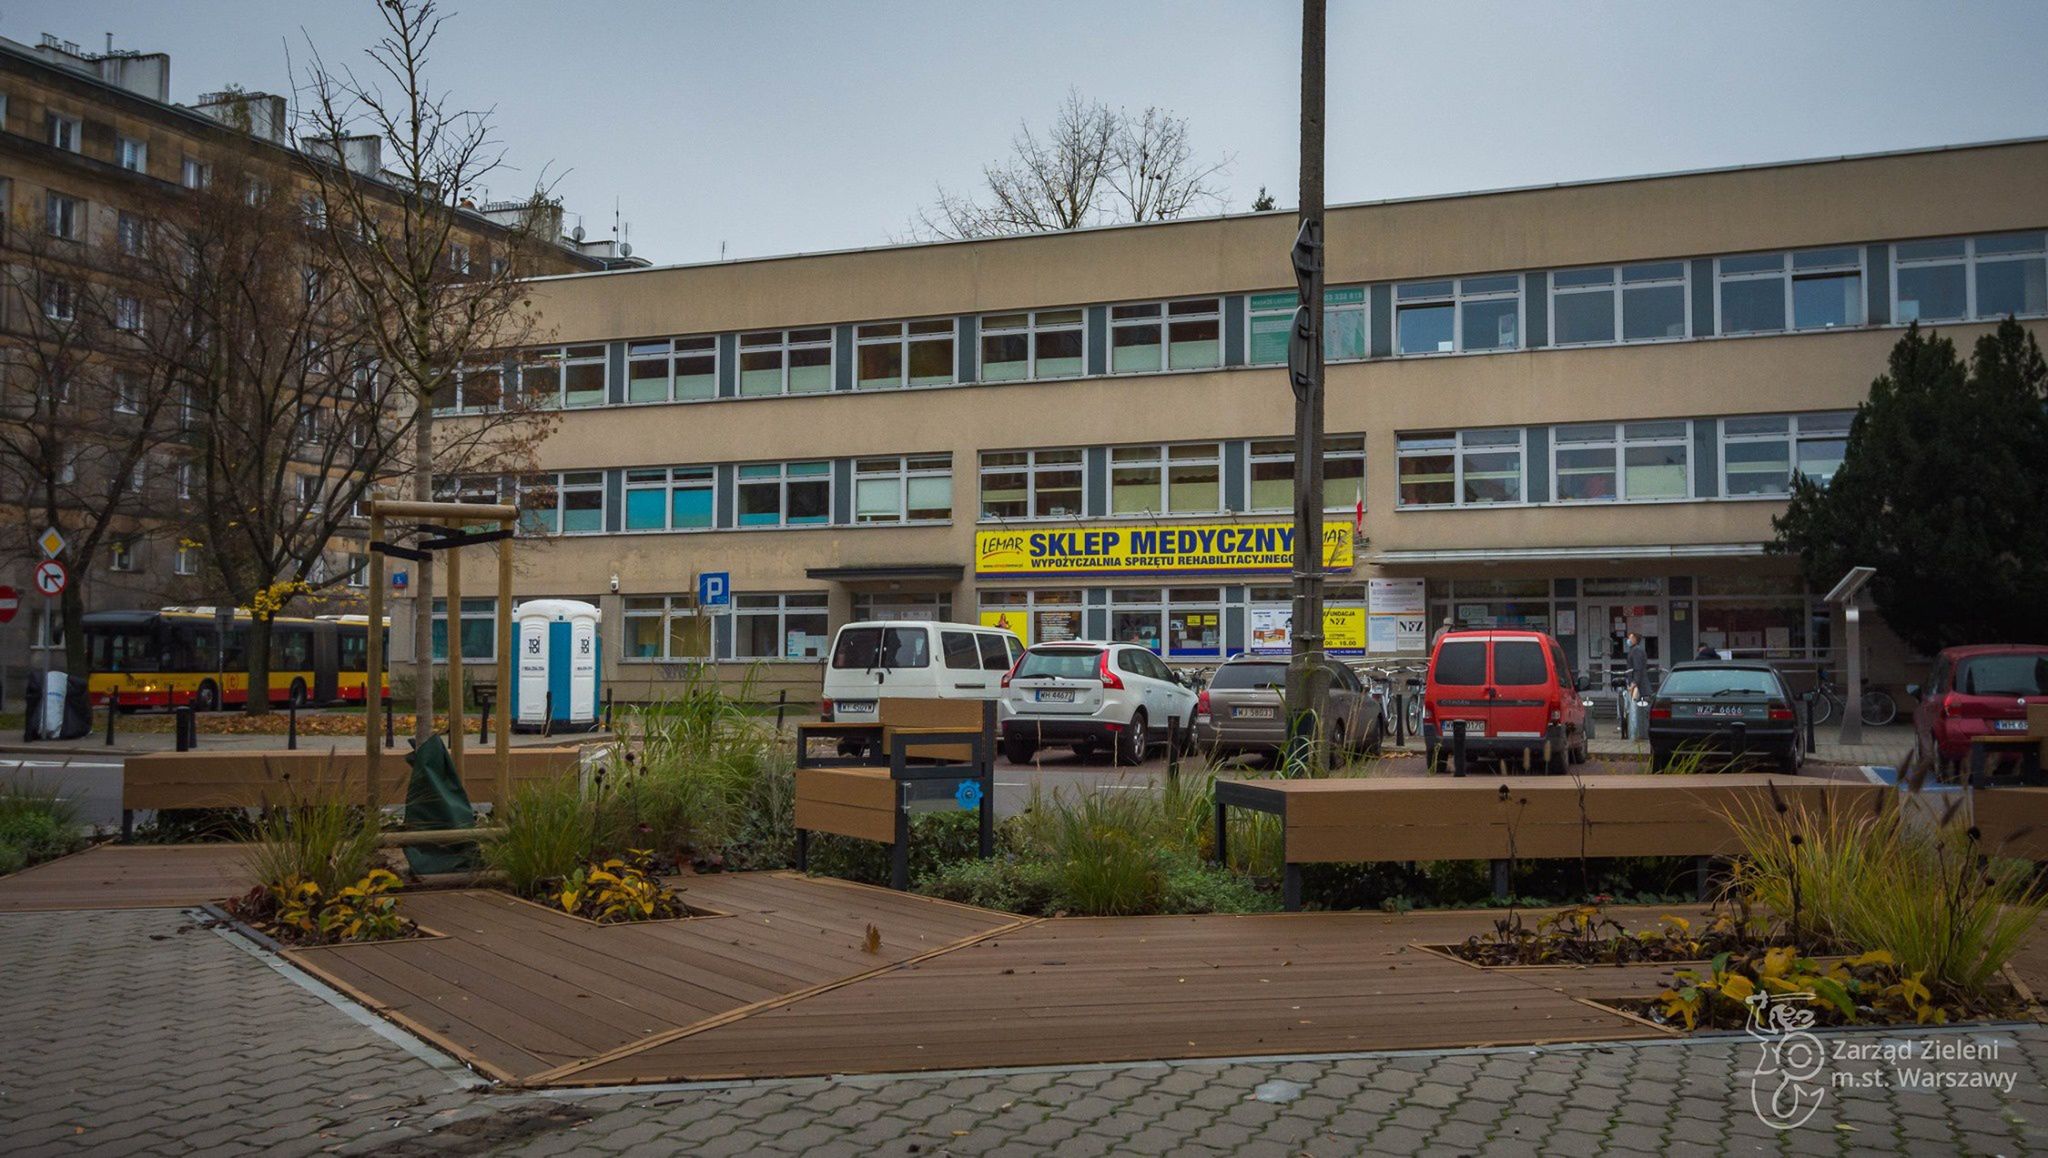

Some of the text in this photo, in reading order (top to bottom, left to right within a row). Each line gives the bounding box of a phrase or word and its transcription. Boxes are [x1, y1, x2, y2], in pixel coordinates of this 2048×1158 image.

[983, 537, 1024, 555] LEMAR
[1029, 532, 1120, 557] SKLEP
[1131, 527, 1295, 554] MEDYCZNY
[1031, 556, 1121, 568] WYPOŻYCZALNIA
[1125, 555, 1174, 568] SPRZĘTU
[707, 577, 723, 604] P
[1329, 617, 1347, 625] NFZ
[1400, 621, 1424, 632] NFZ
